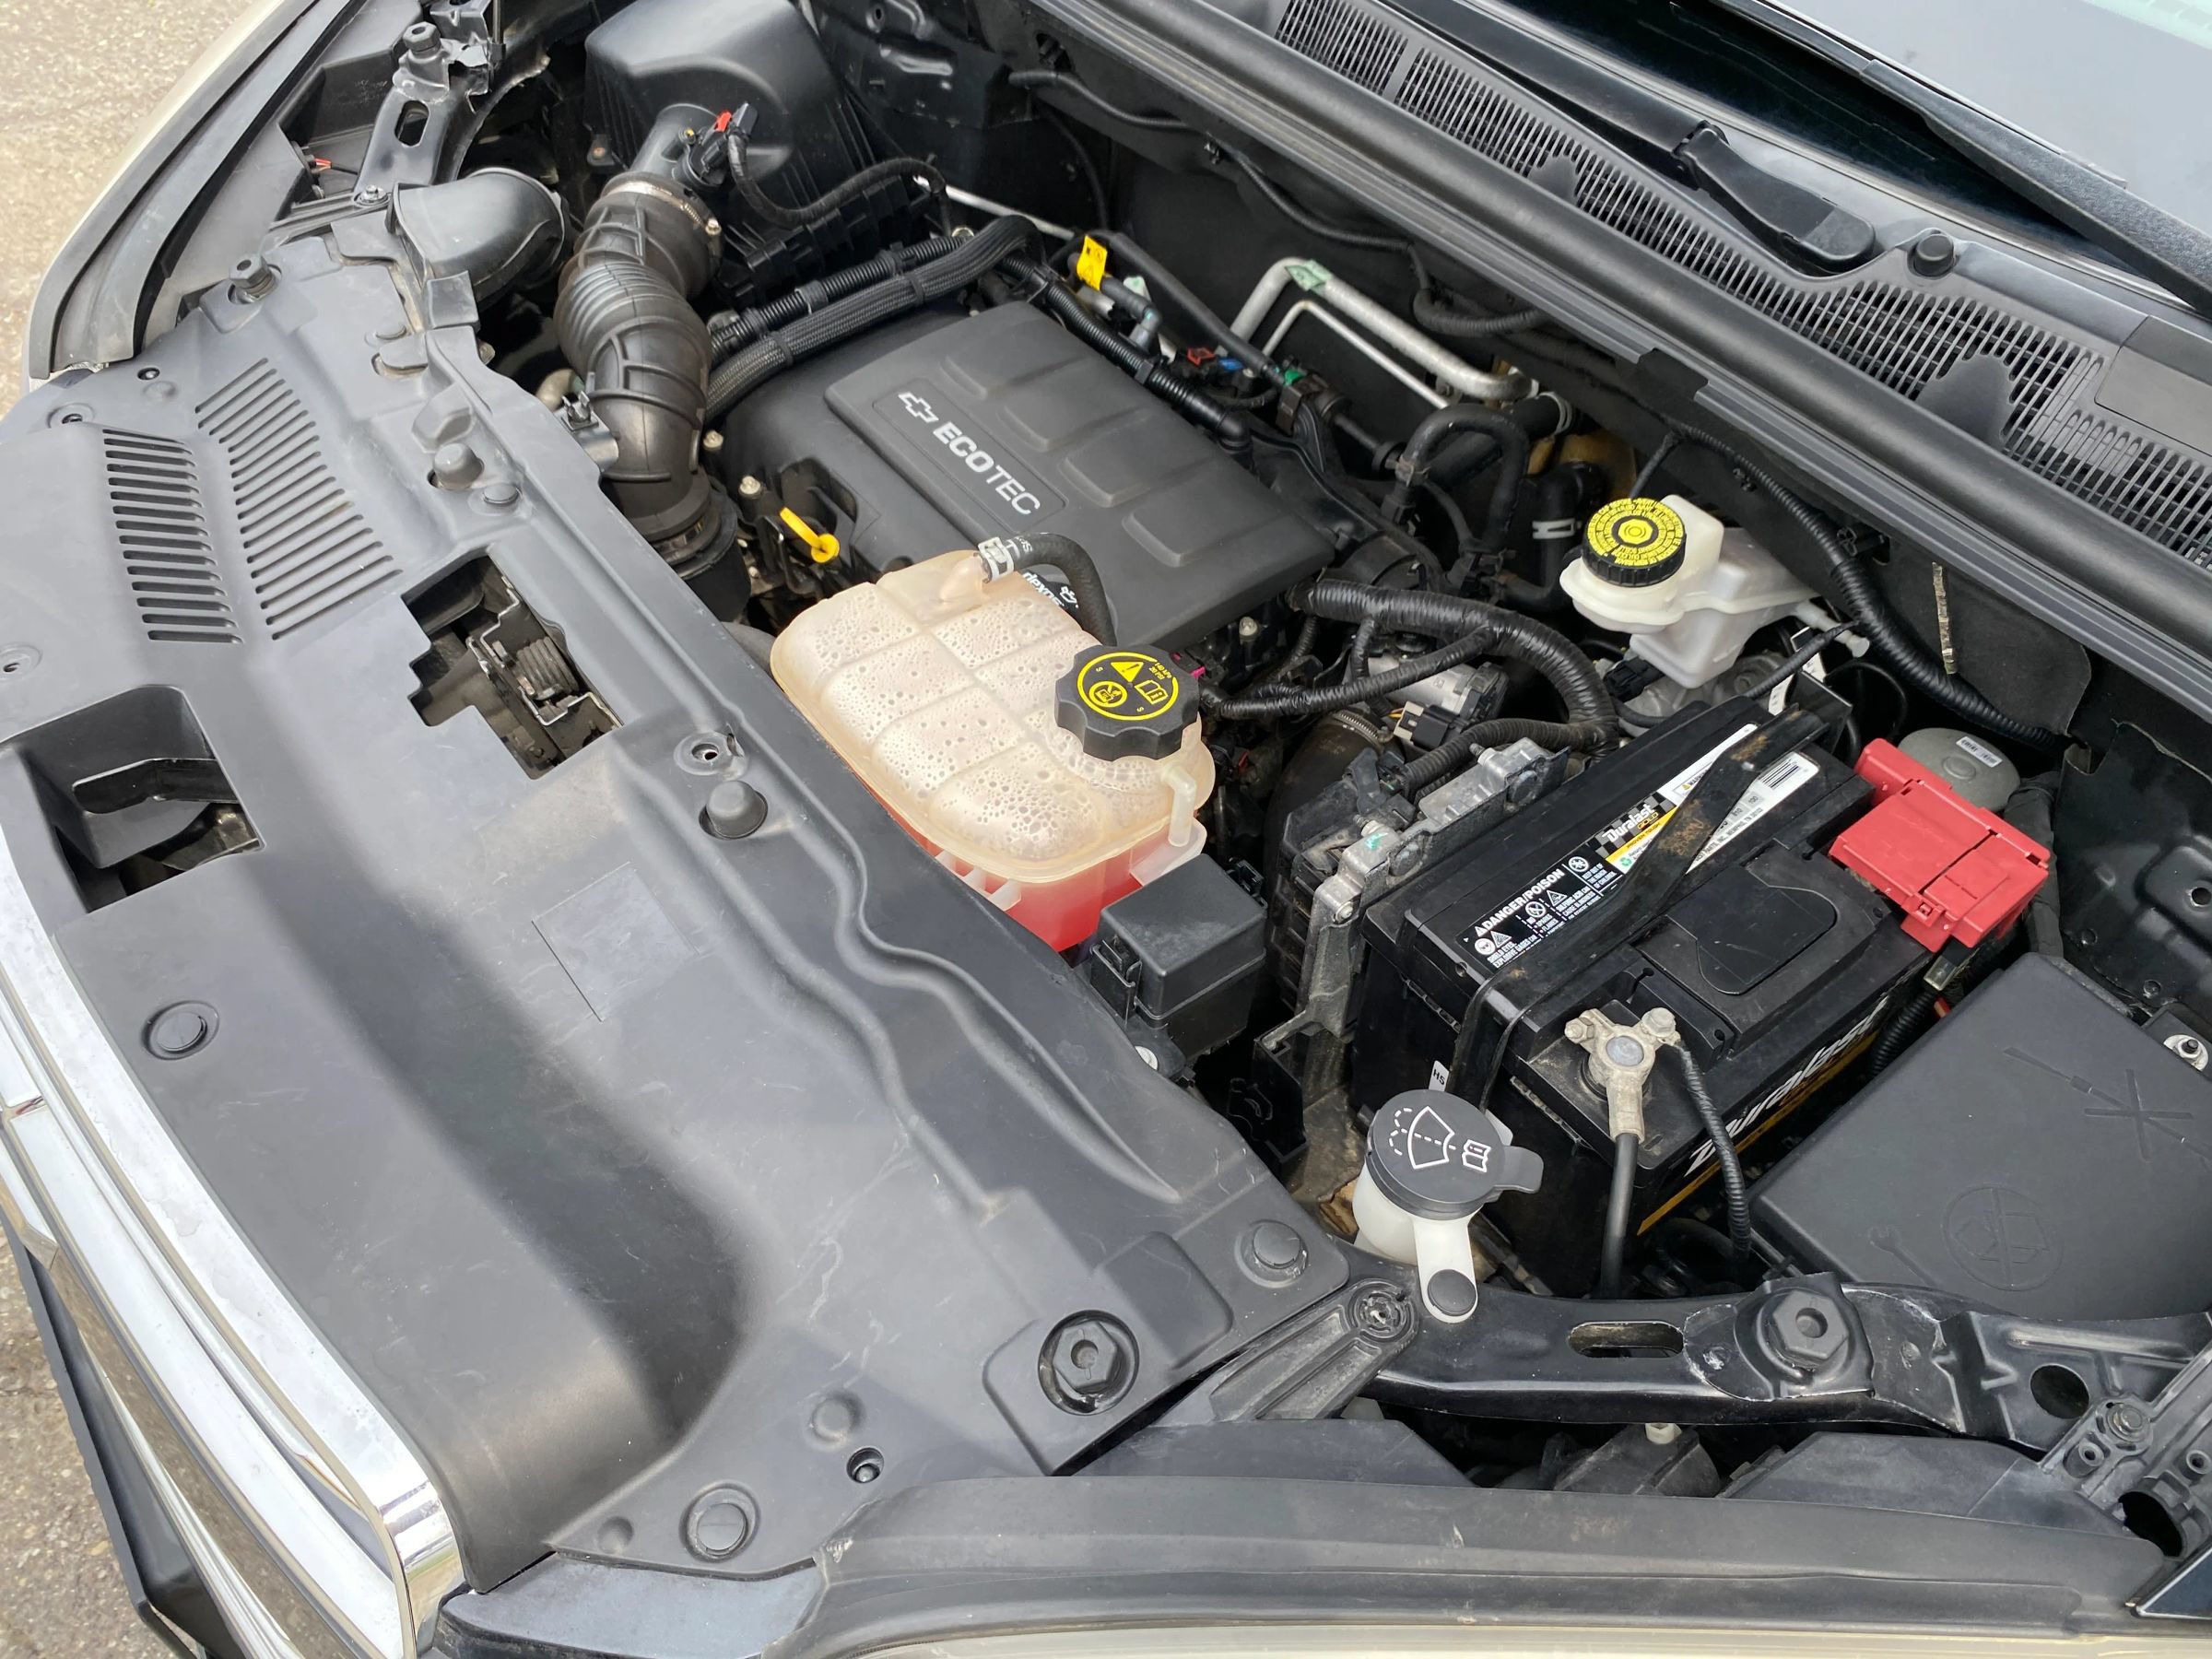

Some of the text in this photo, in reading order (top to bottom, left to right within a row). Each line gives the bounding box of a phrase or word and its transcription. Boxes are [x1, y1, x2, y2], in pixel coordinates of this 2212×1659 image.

[933, 421, 1040, 515] ECOTEC
[1601, 802, 1654, 841] Duralast
[1481, 868, 1565, 930] DANGER/POISON
